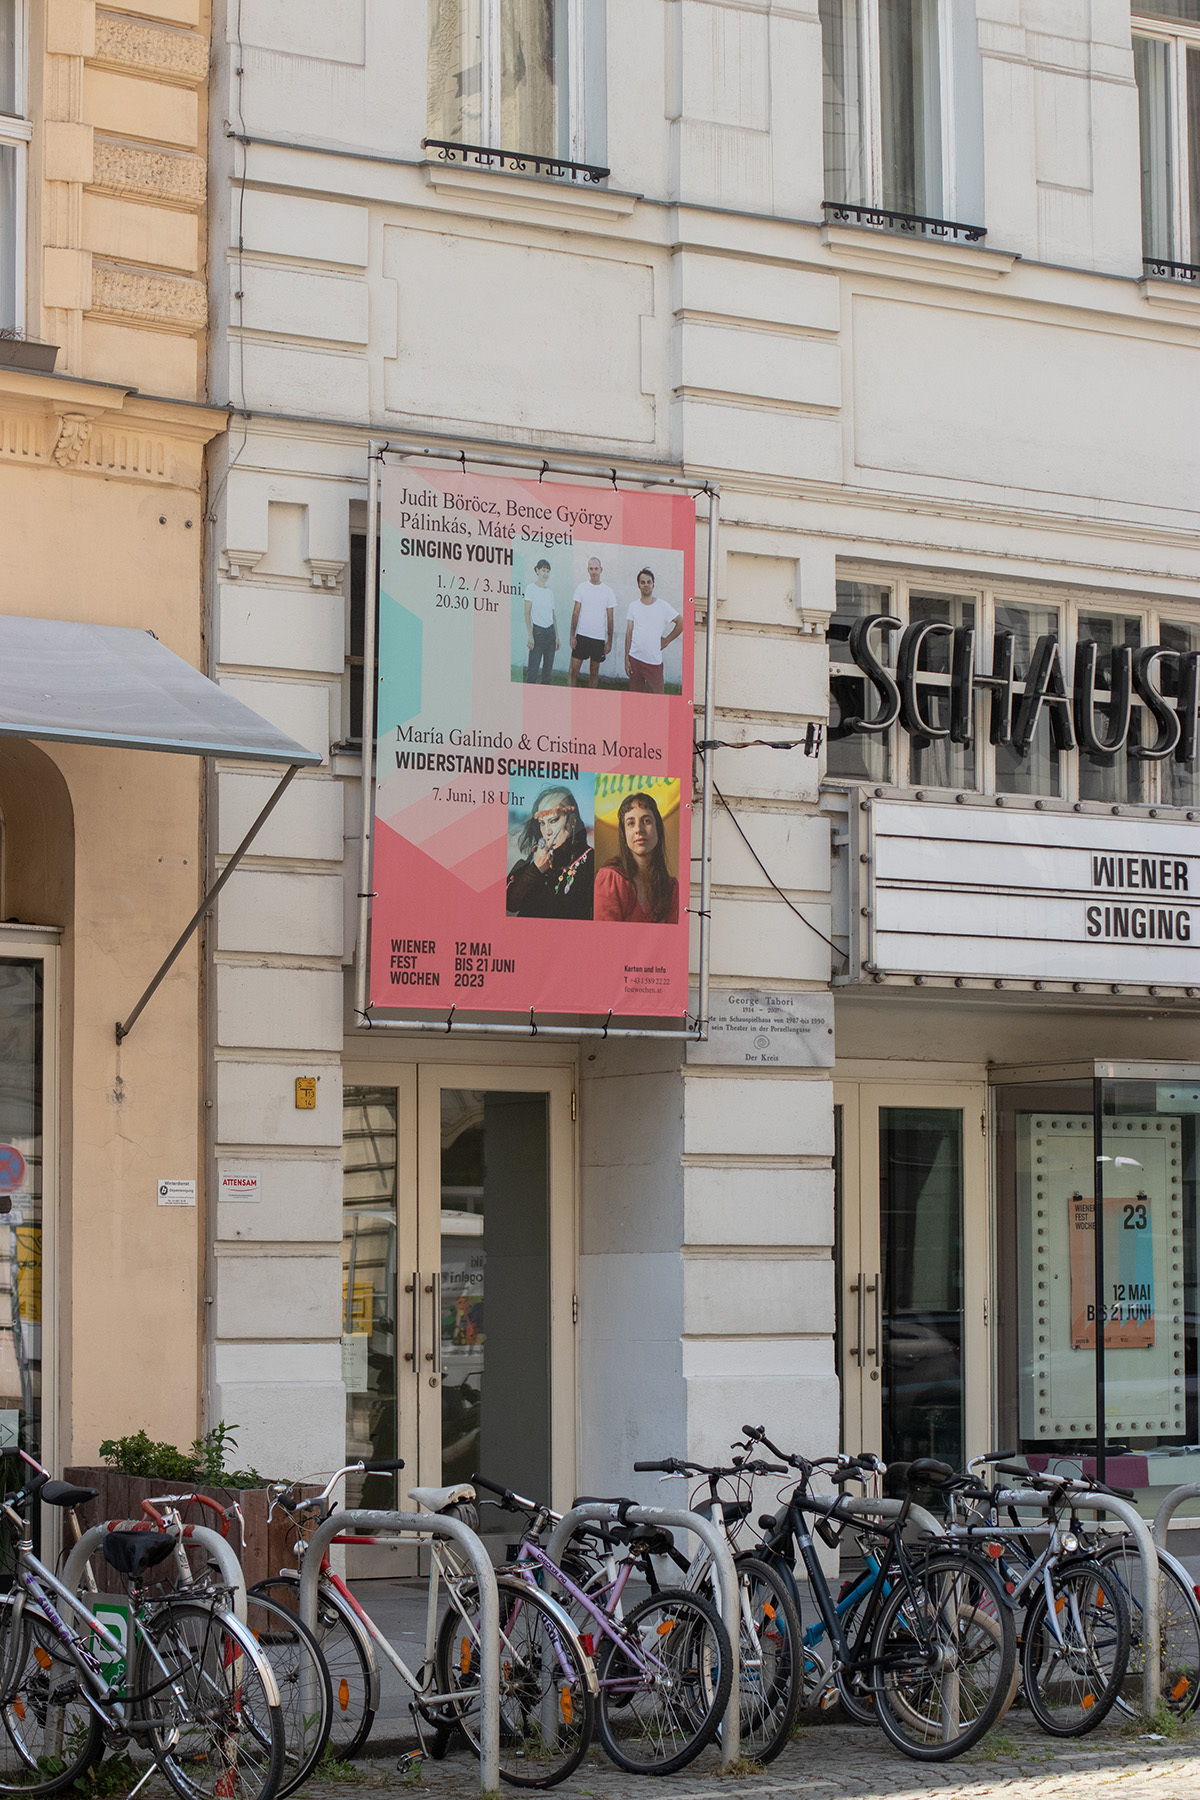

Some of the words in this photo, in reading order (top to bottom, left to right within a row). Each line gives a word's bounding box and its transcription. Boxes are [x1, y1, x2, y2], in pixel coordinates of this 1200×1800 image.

[400, 488, 438, 508] Judit
[442, 492, 501, 517] Böröcz,
[506, 499, 552, 520] Bence
[556, 505, 613, 531] György
[400, 512, 472, 538] Pálinkás,
[478, 519, 516, 539] Máté
[521, 525, 573, 548] Szigeti
[400, 538, 462, 561] SINGING
[466, 544, 514, 566] YOUTH
[437, 574, 446, 589] 1.
[458, 576, 470, 591] 2.
[483, 578, 493, 593] 3.
[497, 580, 526, 598] Juni,
[435, 594, 469, 610] 20.30
[473, 596, 499, 612] Uhr
[395, 725, 444, 745] María
[449, 729, 513, 750] Galindo
[517, 733, 532, 751] &
[537, 735, 597, 756] Cristina
[601, 739, 663, 761] Morales
[395, 750, 494, 775] WIDERSTAND
[497, 757, 579, 781] SCHREIBEN
[432, 787, 442, 801] 7.
[446, 788, 476, 805] Juni,
[481, 790, 495, 804] 18
[500, 791, 525, 806] Uhr
[1093, 856, 1189, 891] WIENER
[1086, 906, 1190, 941] SINGING
[391, 939, 436, 954] WIENER
[455, 942, 467, 955] 12
[470, 943, 491, 956] MAI
[391, 955, 418, 969] FEST
[455, 958, 473, 972] BIS
[476, 958, 488, 972] 21
[491, 959, 515, 973] JUNI
[390, 971, 440, 986] WOCHEN
[454, 974, 485, 987] 2023
[728, 995, 759, 1006] George
[765, 996, 794, 1006] Tabori
[745, 1053, 758, 1061] Der
[761, 1054, 779, 1062] Kreis
[222, 1178, 257, 1187] ATTENSAM
[1075, 1204, 1095, 1213] WIENE
[1075, 1213, 1088, 1221] FEST
[1123, 1204, 1147, 1230] 23
[1075, 1222, 1095, 1230] WOCHE
[1113, 1284, 1125, 1301] 12
[1128, 1284, 1150, 1301] MAI
[1111, 1303, 1122, 1321] 21
[1126, 1303, 1151, 1321] JUNI
